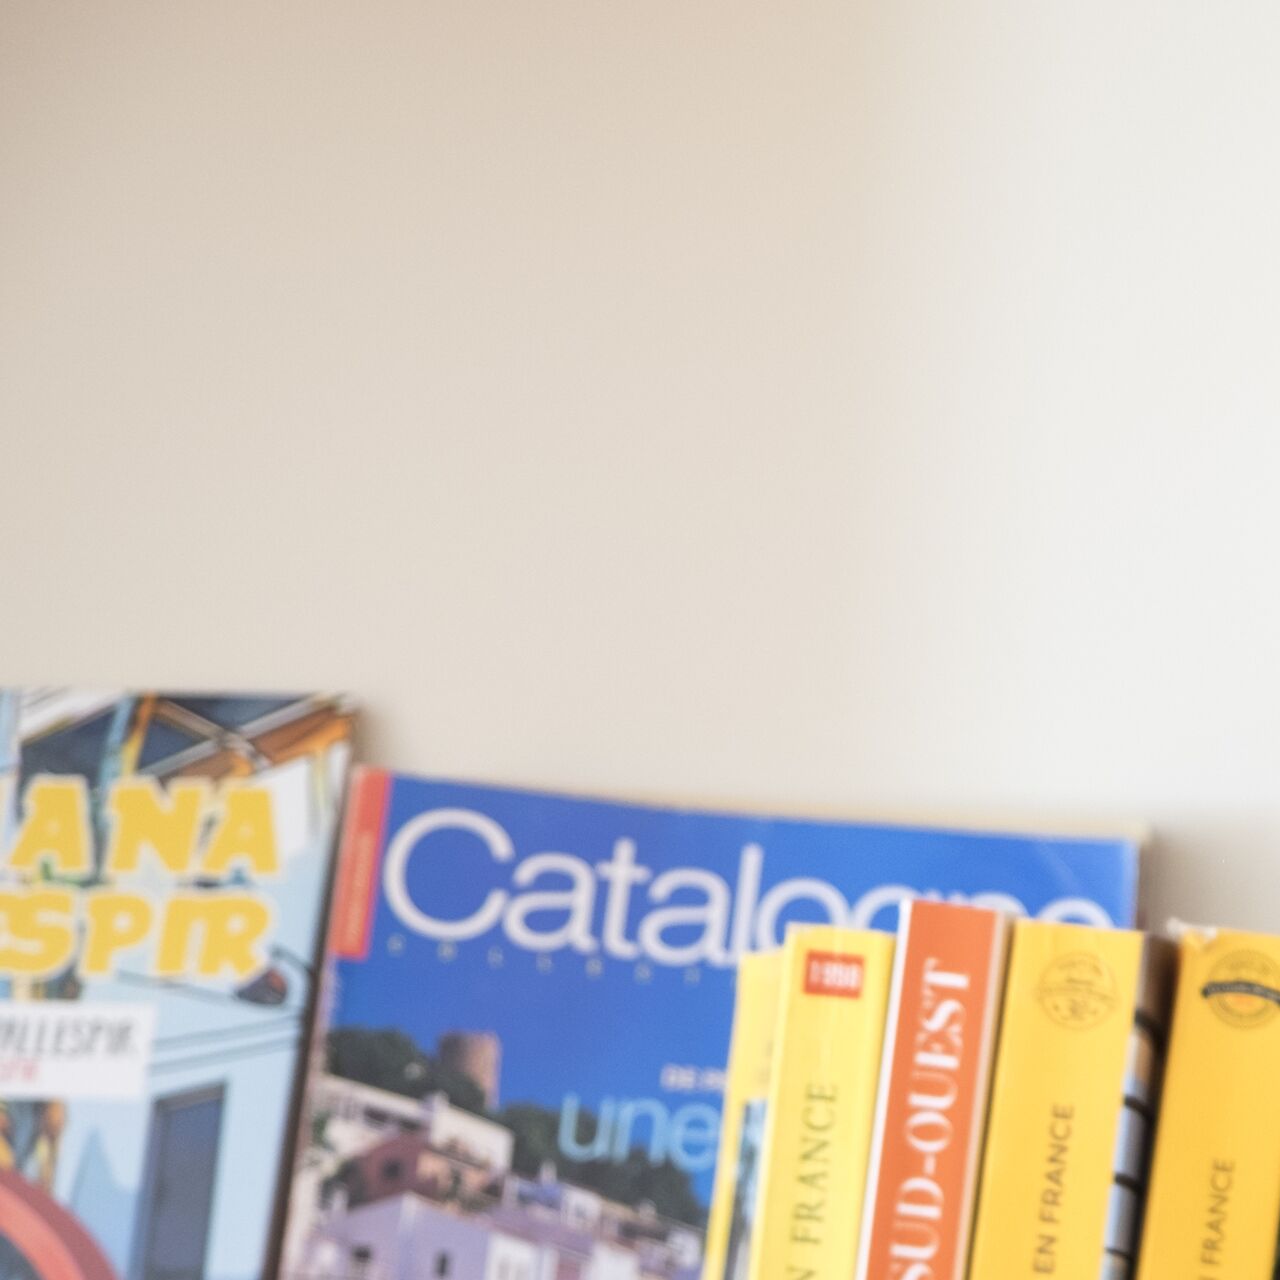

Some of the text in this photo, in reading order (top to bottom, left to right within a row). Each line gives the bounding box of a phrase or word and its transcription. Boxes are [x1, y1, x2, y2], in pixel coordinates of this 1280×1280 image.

[8, 780, 281, 876] ANA
[558, 1092, 718, 1171] une
[790, 1083, 838, 1245] FRANCE
[1040, 1102, 1075, 1225] FRANCE
[1032, 1234, 1057, 1274] EN
[1201, 1158, 1235, 1267] FRANCE
